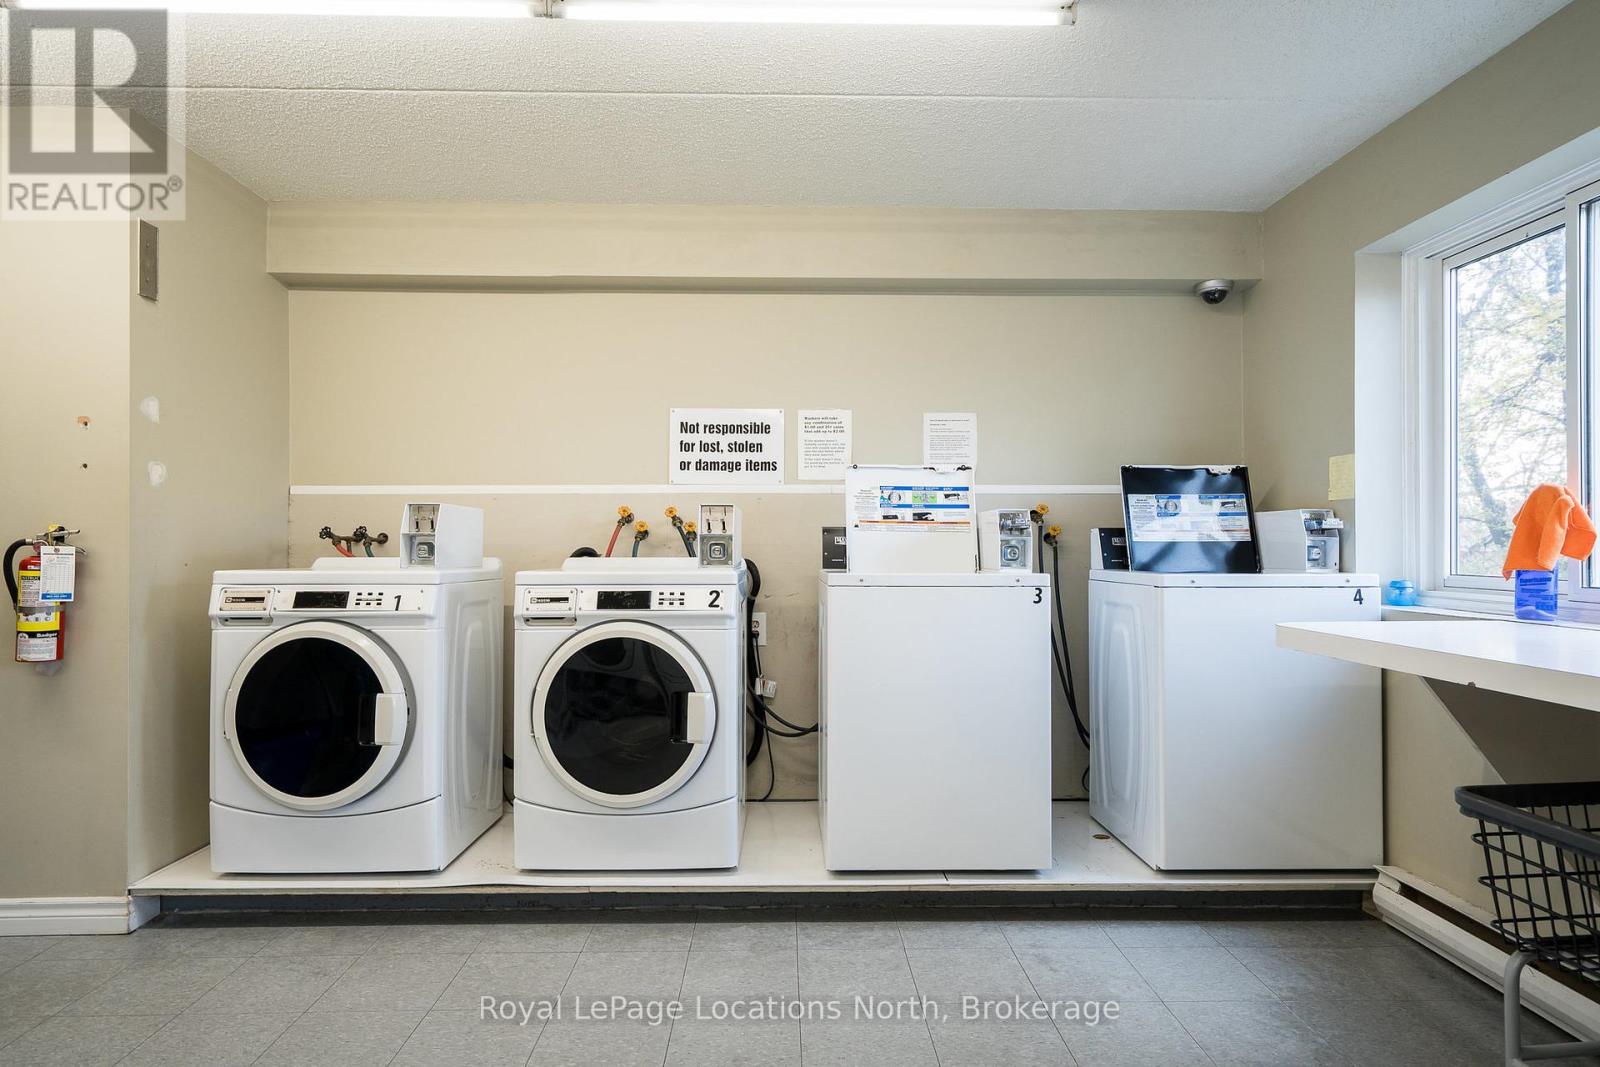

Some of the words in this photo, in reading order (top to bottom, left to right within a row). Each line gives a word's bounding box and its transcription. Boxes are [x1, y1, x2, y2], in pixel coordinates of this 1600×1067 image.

[680, 421, 700, 434] Not
[703, 421, 771, 437] responsible
[680, 440, 695, 453] for
[699, 440, 724, 455] lost,
[728, 440, 763, 453] stolen
[680, 461, 692, 472] or
[695, 459, 742, 473] damage
[745, 459, 778, 472] items
[394, 595, 402, 612] 1
[708, 590, 721, 608] 2
[1032, 587, 1043, 604] 3
[1353, 588, 1364, 605] 4
